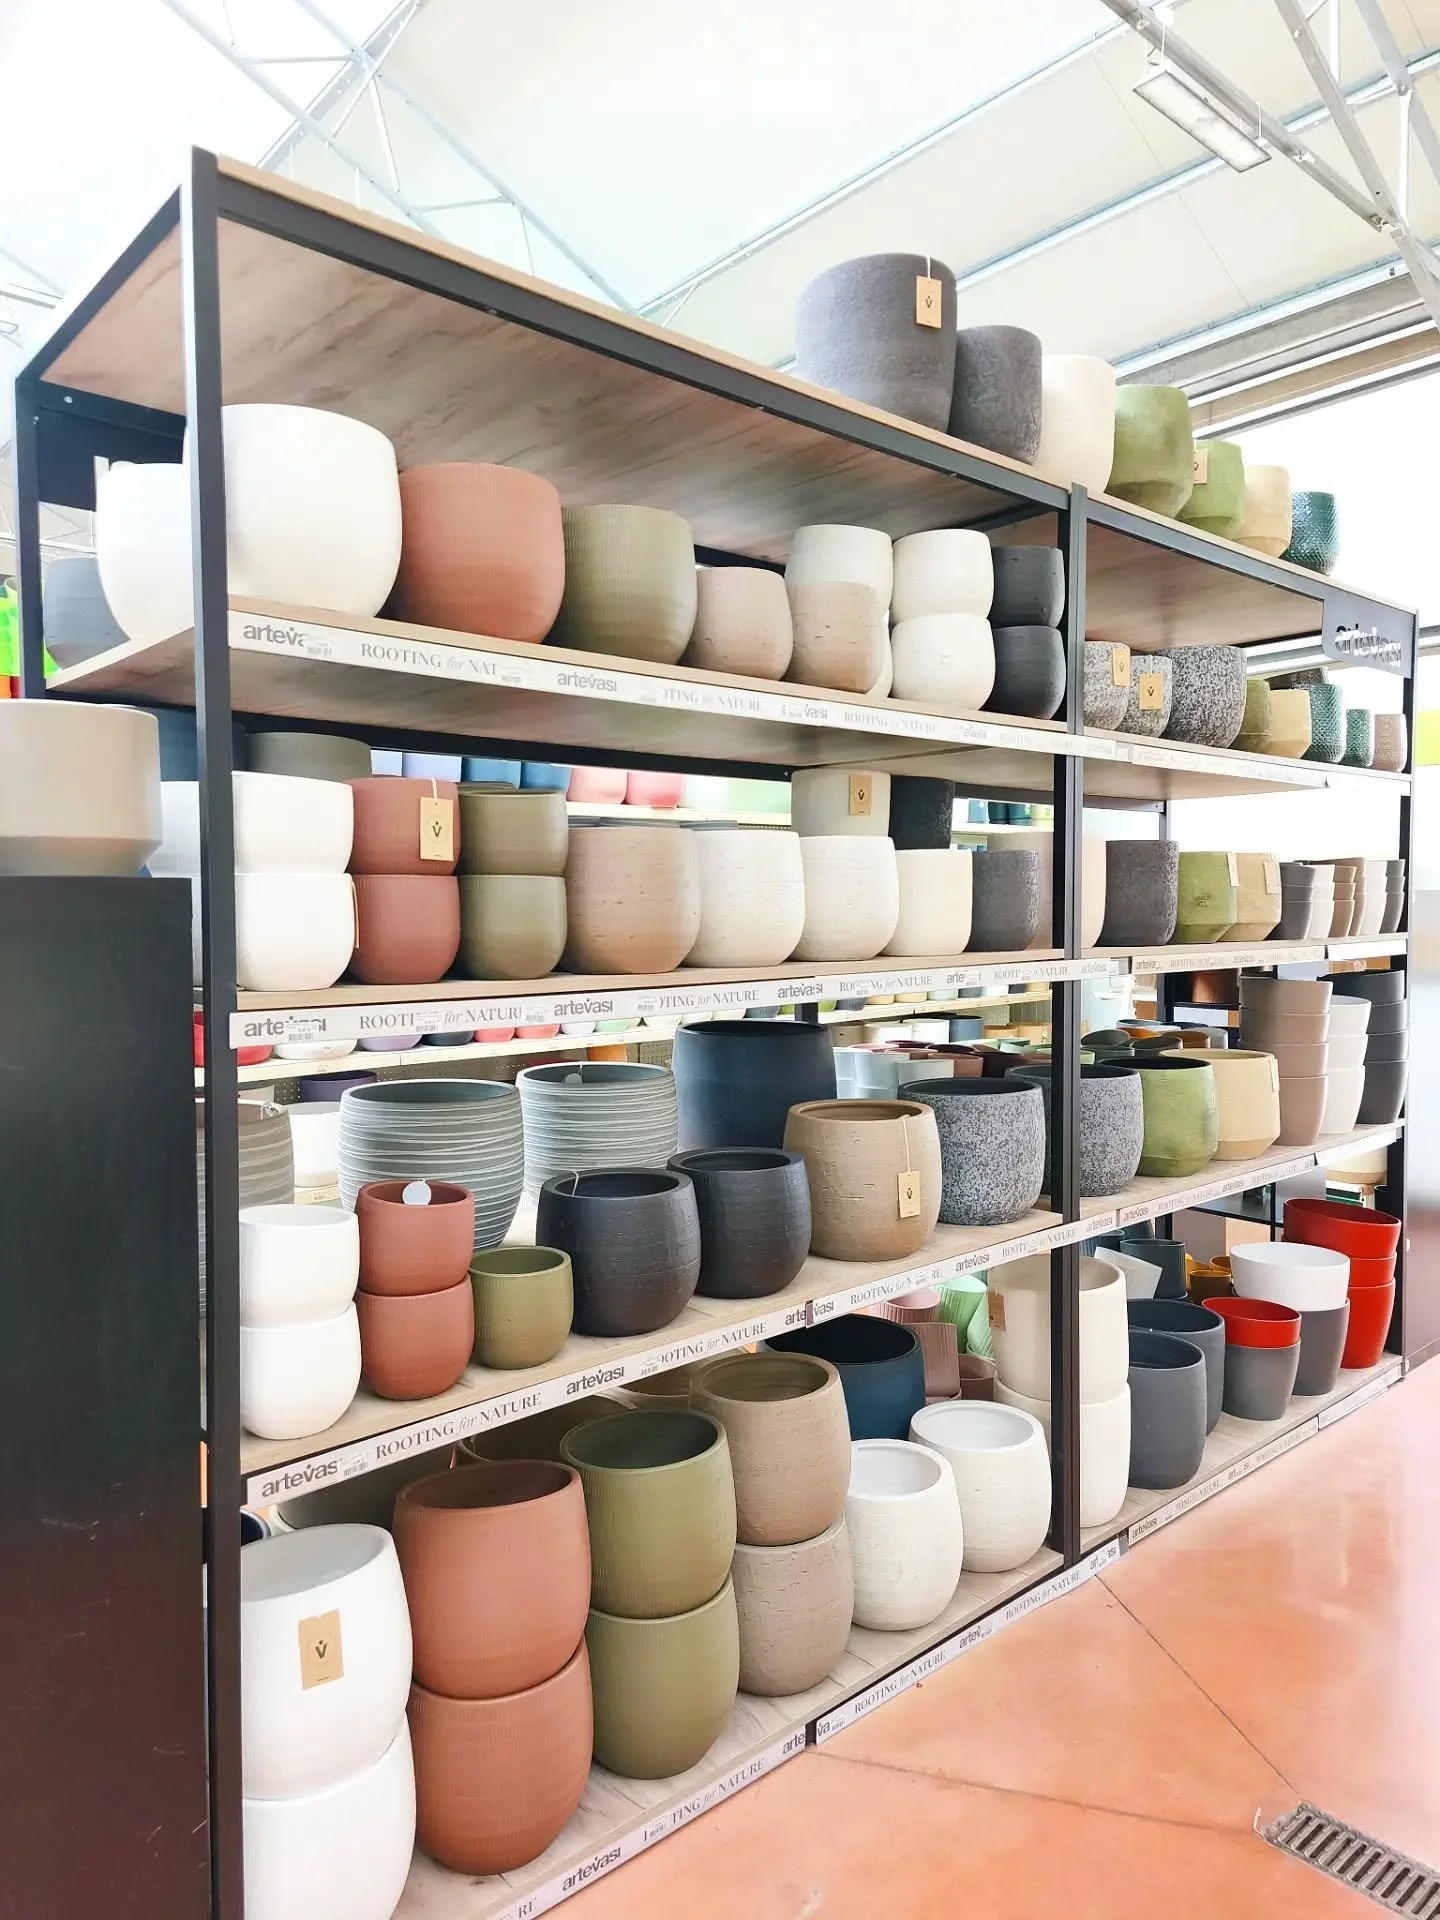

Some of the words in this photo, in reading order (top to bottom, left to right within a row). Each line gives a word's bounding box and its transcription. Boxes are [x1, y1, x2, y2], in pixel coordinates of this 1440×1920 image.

[1334, 623, 1401, 667] artevasi
[361, 642, 442, 669] ROOTING
[468, 658, 499, 676] NAT
[557, 671, 618, 693] artevasi
[844, 710, 889, 728] ROOTING
[1135, 958, 1157, 971] arteva
[897, 974, 933, 990] NATURE
[553, 997, 613, 1017] artevasi
[696, 991, 712, 1009] for
[712, 988, 760, 1005] NATURE
[359, 1012, 415, 1030] ROOTI
[444, 1009, 463, 1026] for
[1087, 1215, 1113, 1233] artevasi
[1123, 1206, 1150, 1222] artevasi
[1046, 1226, 1077, 1243] NATURE
[954, 1252, 990, 1273] artevasi
[850, 1282, 893, 1306] ROOTING
[720, 1320, 768, 1345] NATURE
[566, 1366, 625, 1396] artevasi
[375, 1420, 455, 1460] ROOTING
[456, 1413, 479, 1436] for
[479, 1391, 543, 1427] NATURE
[262, 1457, 340, 1498] artevas
[1131, 1515, 1158, 1540] artevasi
[1005, 1592, 1042, 1621] ROOTING
[1051, 1569, 1081, 1594] NATURE
[854, 1680, 898, 1715] ROOTING
[909, 1649, 948, 1679] NATURE
[700, 1786, 718, 1809] for
[717, 1756, 765, 1794] NATURE
[562, 1846, 622, 1892] artevasi
